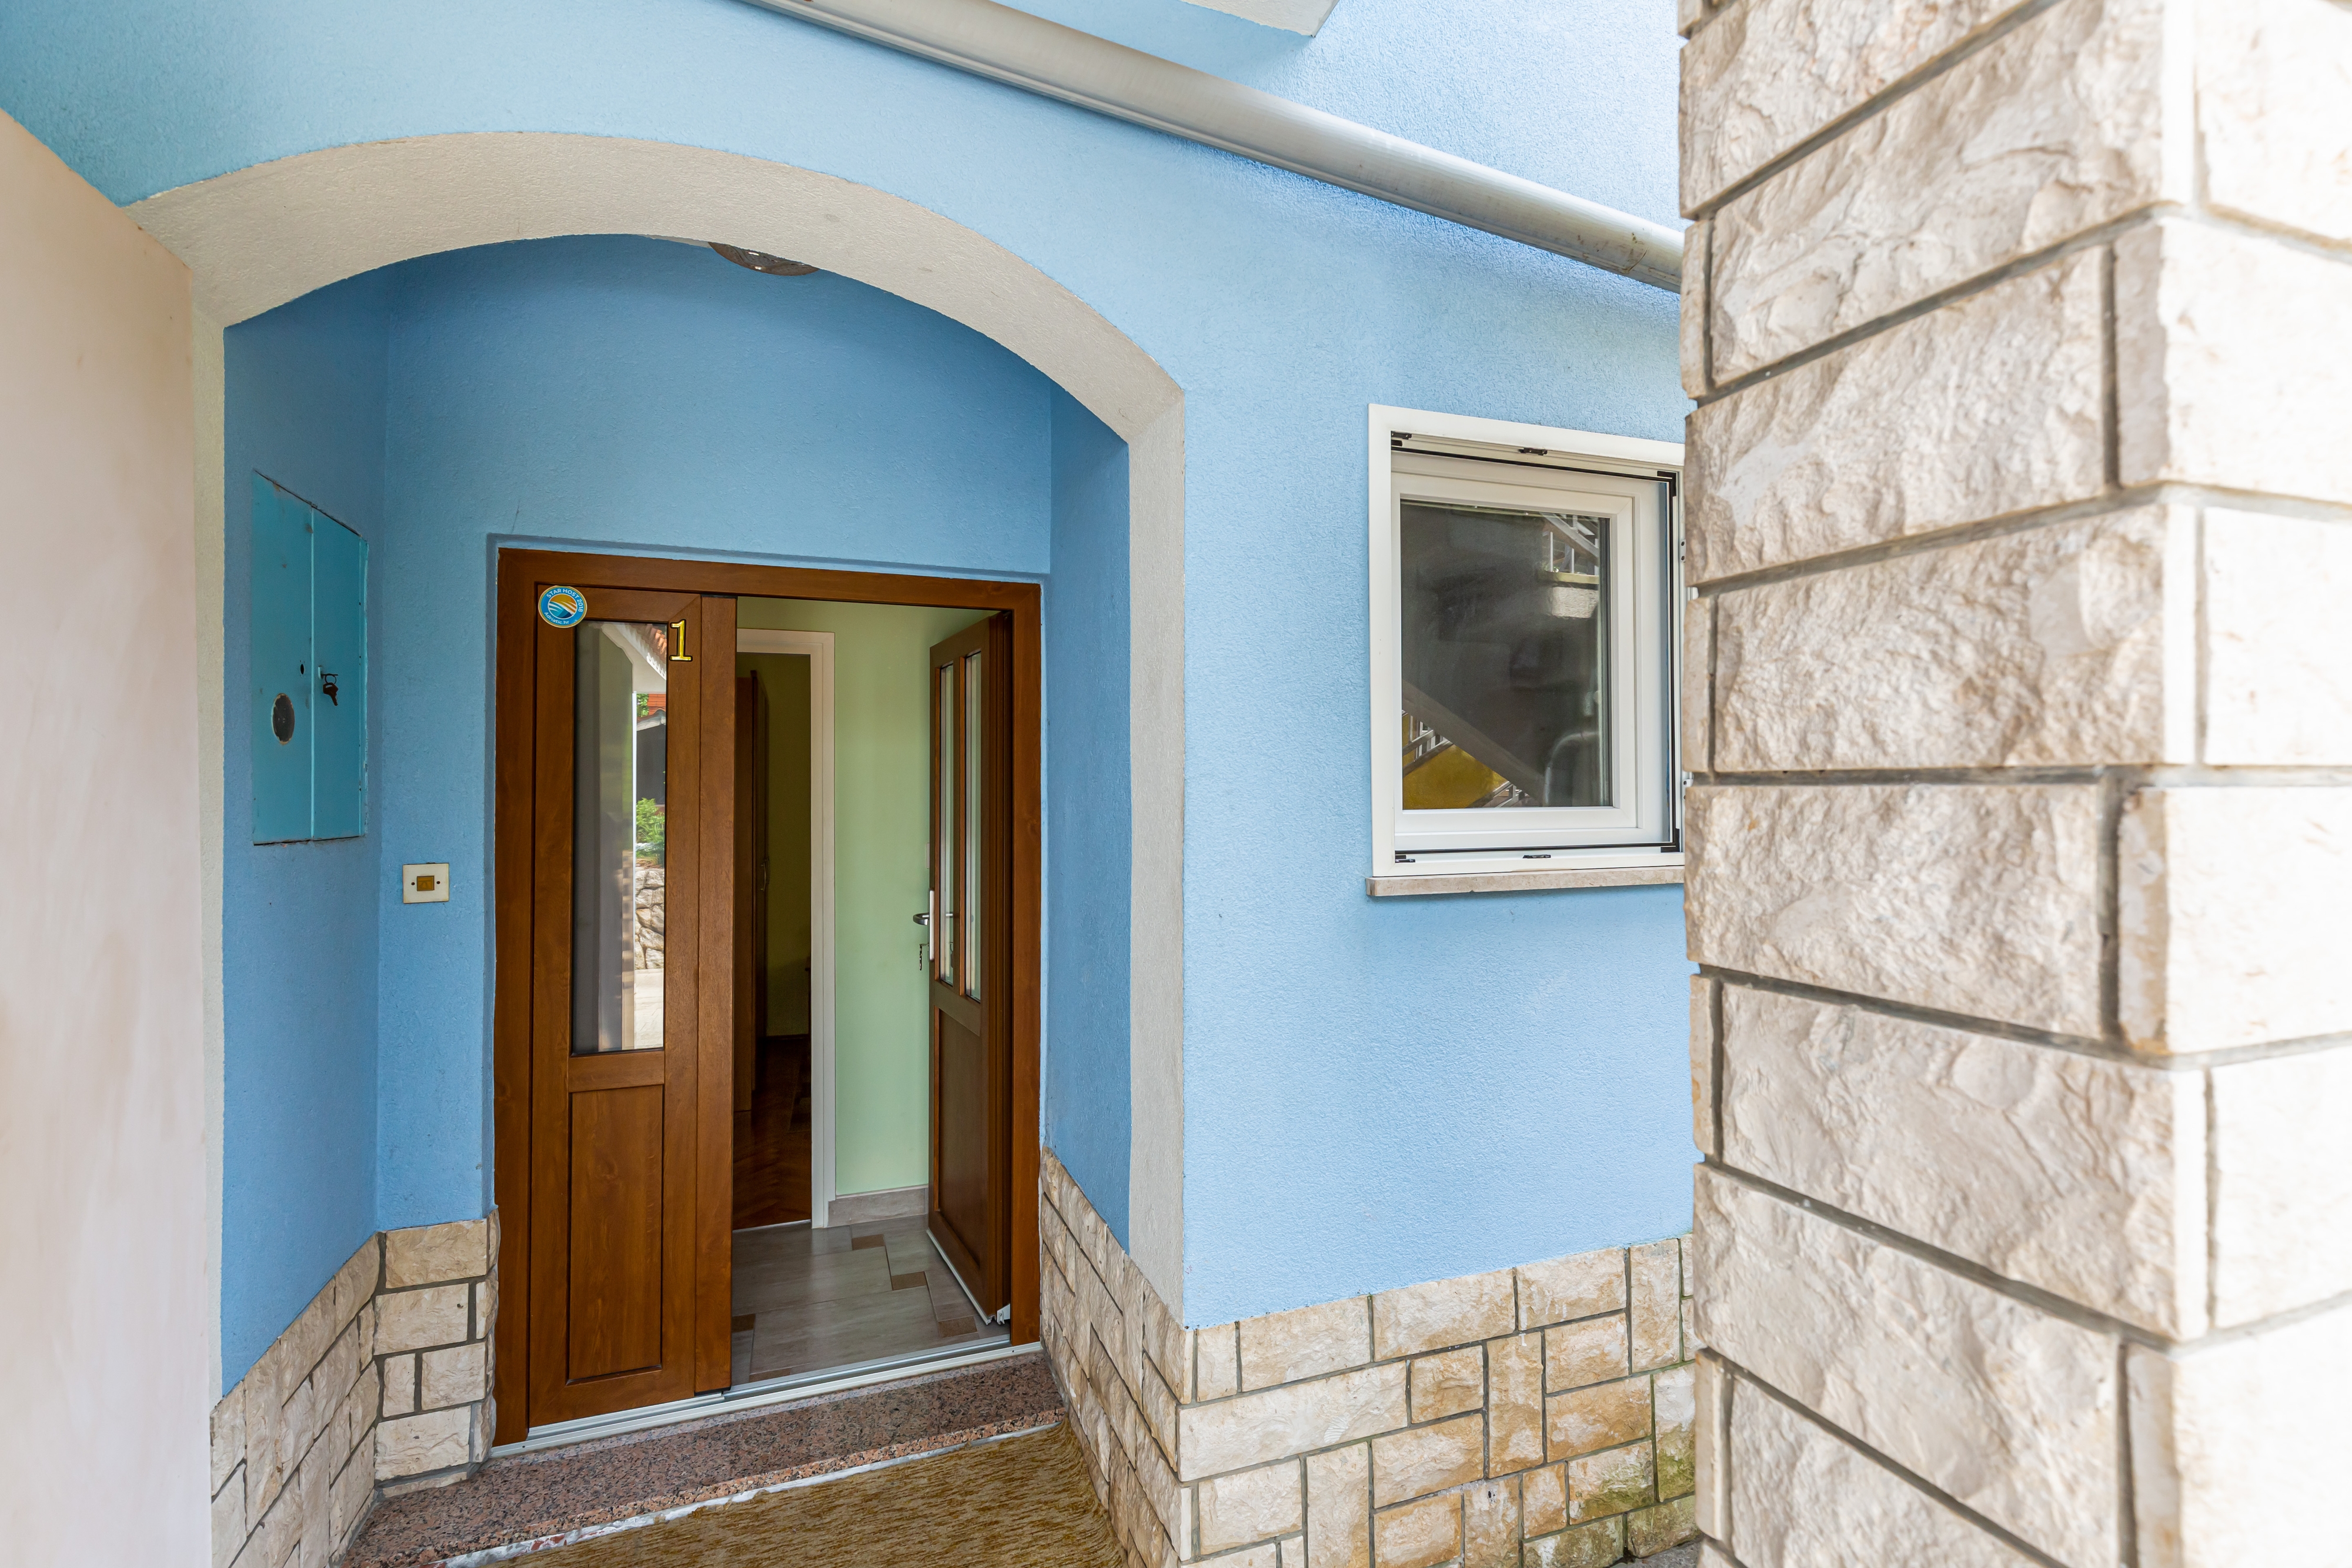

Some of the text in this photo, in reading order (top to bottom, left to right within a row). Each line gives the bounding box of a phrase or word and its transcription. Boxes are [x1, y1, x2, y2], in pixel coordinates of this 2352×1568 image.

[546, 589, 562, 598] STAR
[563, 589, 580, 599] HOST
[544, 612, 569, 624] Adriatic.hr
[670, 619, 692, 661] 1
